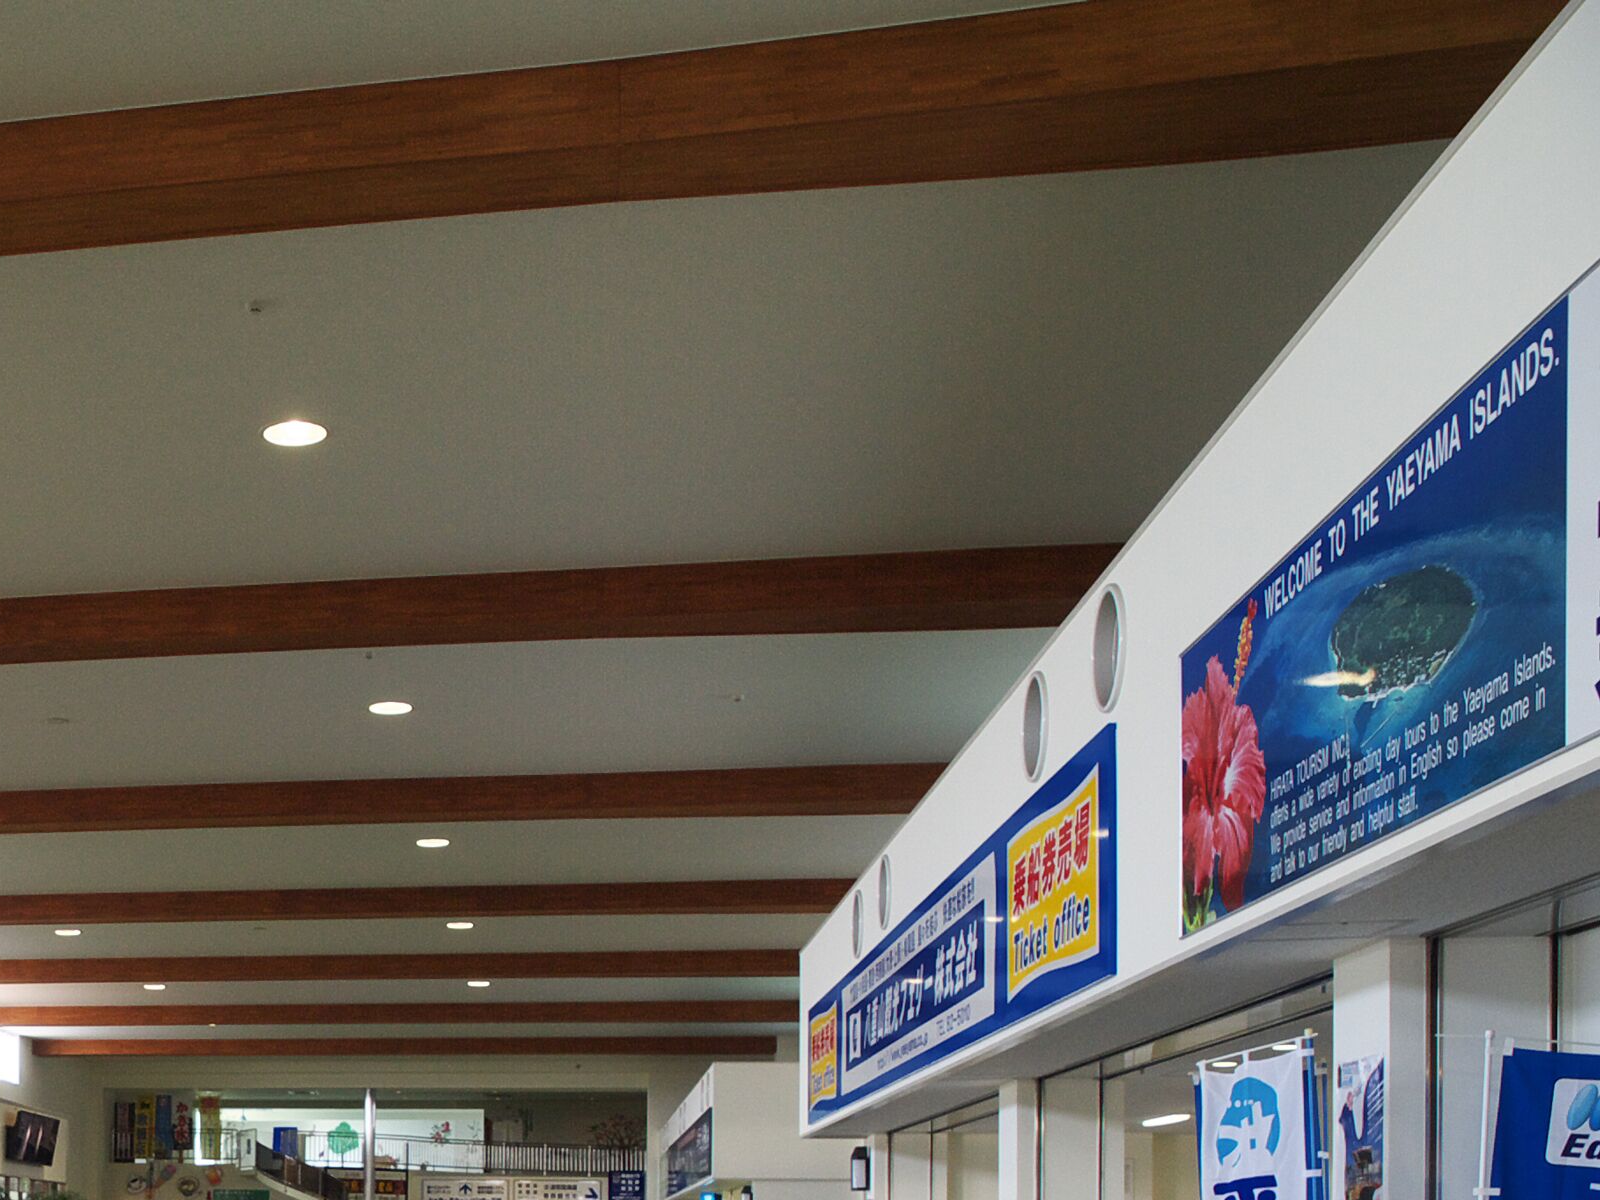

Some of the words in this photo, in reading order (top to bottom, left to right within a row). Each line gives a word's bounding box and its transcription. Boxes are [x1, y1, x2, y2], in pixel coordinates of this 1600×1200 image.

[1265, 539, 1322, 619] WELCOME
[1328, 519, 1345, 562] TO
[1352, 486, 1379, 541] THE
[1387, 414, 1461, 510] YAEYAMA
[1470, 328, 1559, 439] ISLANDS.
[1271, 833, 1281, 855] We
[1283, 819, 1306, 854] provide
[1309, 806, 1332, 835] service
[1336, 791, 1350, 820] and
[1353, 771, 1394, 810] information
[1399, 762, 1406, 785] in
[1411, 740, 1442, 787] English
[1447, 736, 1458, 759] so
[1463, 716, 1495, 757] please
[1501, 696, 1529, 730] come
[1536, 683, 1545, 711] in
[1271, 769, 1293, 801] HIRATA
[1296, 745, 1329, 784] TOURISM
[1292, 800, 1296, 816] a
[1299, 786, 1314, 811] wide
[1317, 771, 1339, 801] variety
[1343, 763, 1351, 786] of
[1354, 747, 1381, 780] exciting
[1386, 736, 1401, 762] day
[1405, 722, 1425, 750] tours
[1430, 712, 1439, 735] to
[1444, 701, 1458, 727] the
[1463, 672, 1508, 715] Yaeyama
[1515, 642, 1555, 686] Islands.
[1012, 800, 1091, 917] 乗船券売場
[1271, 858, 1282, 883] and
[1285, 851, 1295, 875] talk
[1299, 848, 1305, 868] to
[1308, 843, 1319, 863] our
[1322, 825, 1347, 856] friendly
[1351, 813, 1364, 842] and
[1368, 798, 1394, 833] helpful
[1398, 785, 1418, 818] staff.
[1013, 916, 1048, 974] Ticket
[1053, 894, 1090, 950] office
